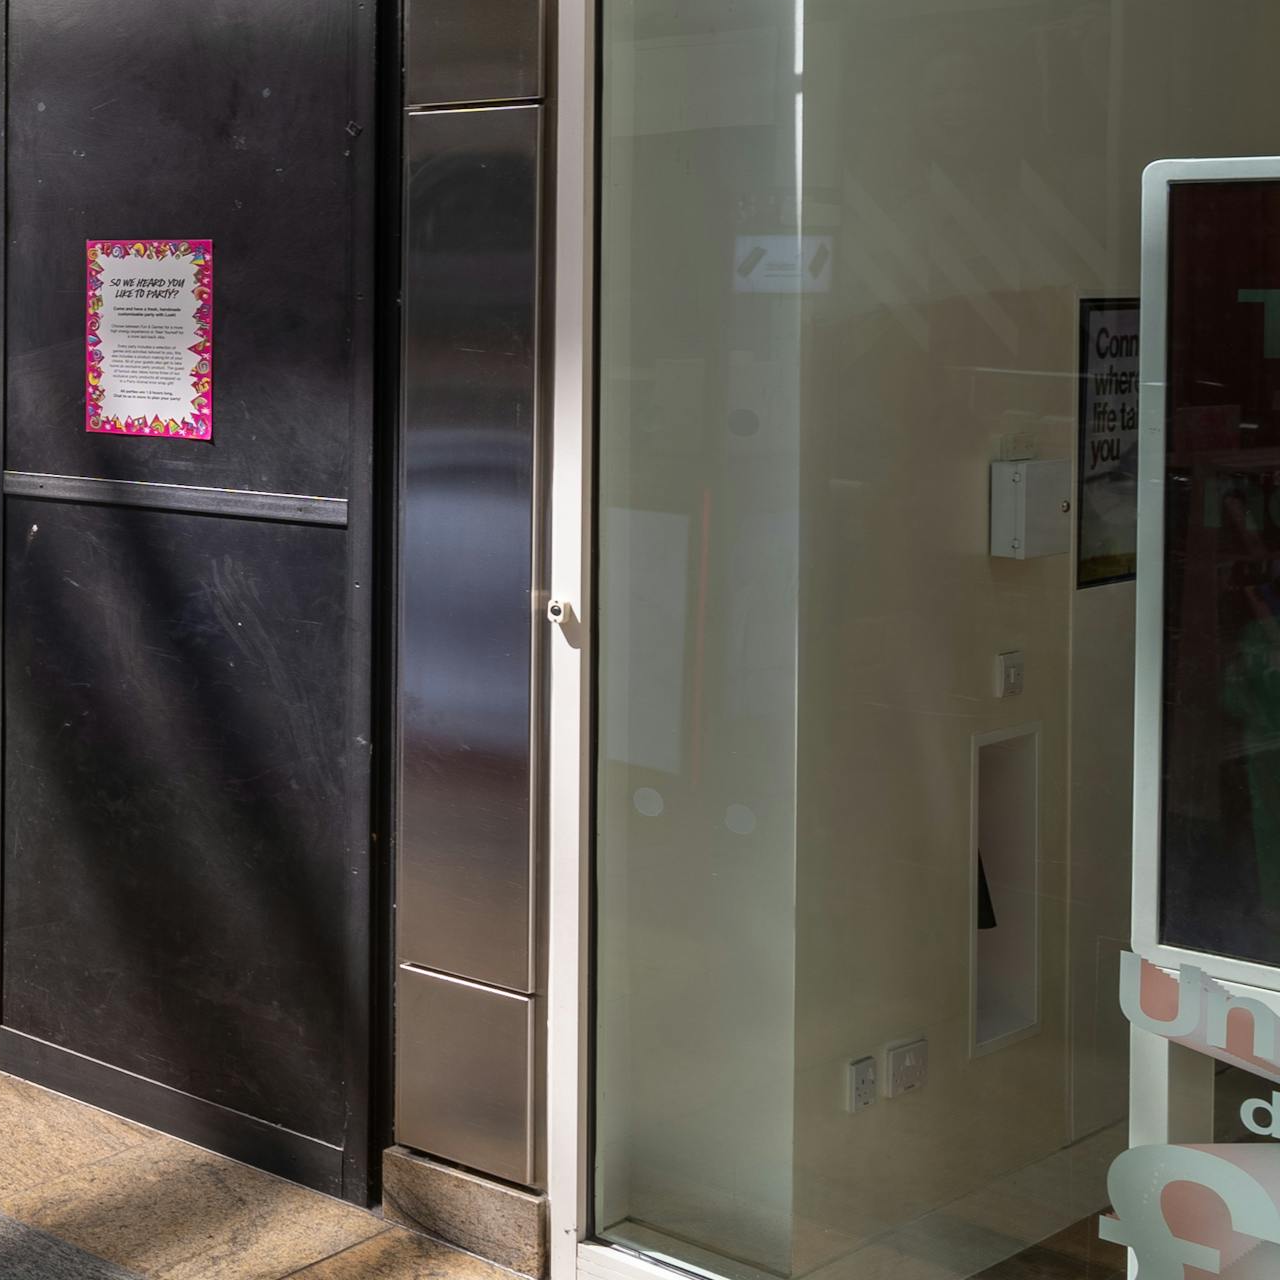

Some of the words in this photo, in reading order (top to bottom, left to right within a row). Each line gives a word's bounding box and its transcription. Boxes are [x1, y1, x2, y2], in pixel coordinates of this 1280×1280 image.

[115, 288, 134, 298] LIKE
[135, 288, 146, 298] TO
[146, 288, 180, 299] PARTY?
[123, 278, 136, 287] WE
[136, 278, 166, 289] HEARD
[167, 278, 186, 288] YOU
[1093, 402, 1116, 433] life
[1091, 437, 1120, 469] you
